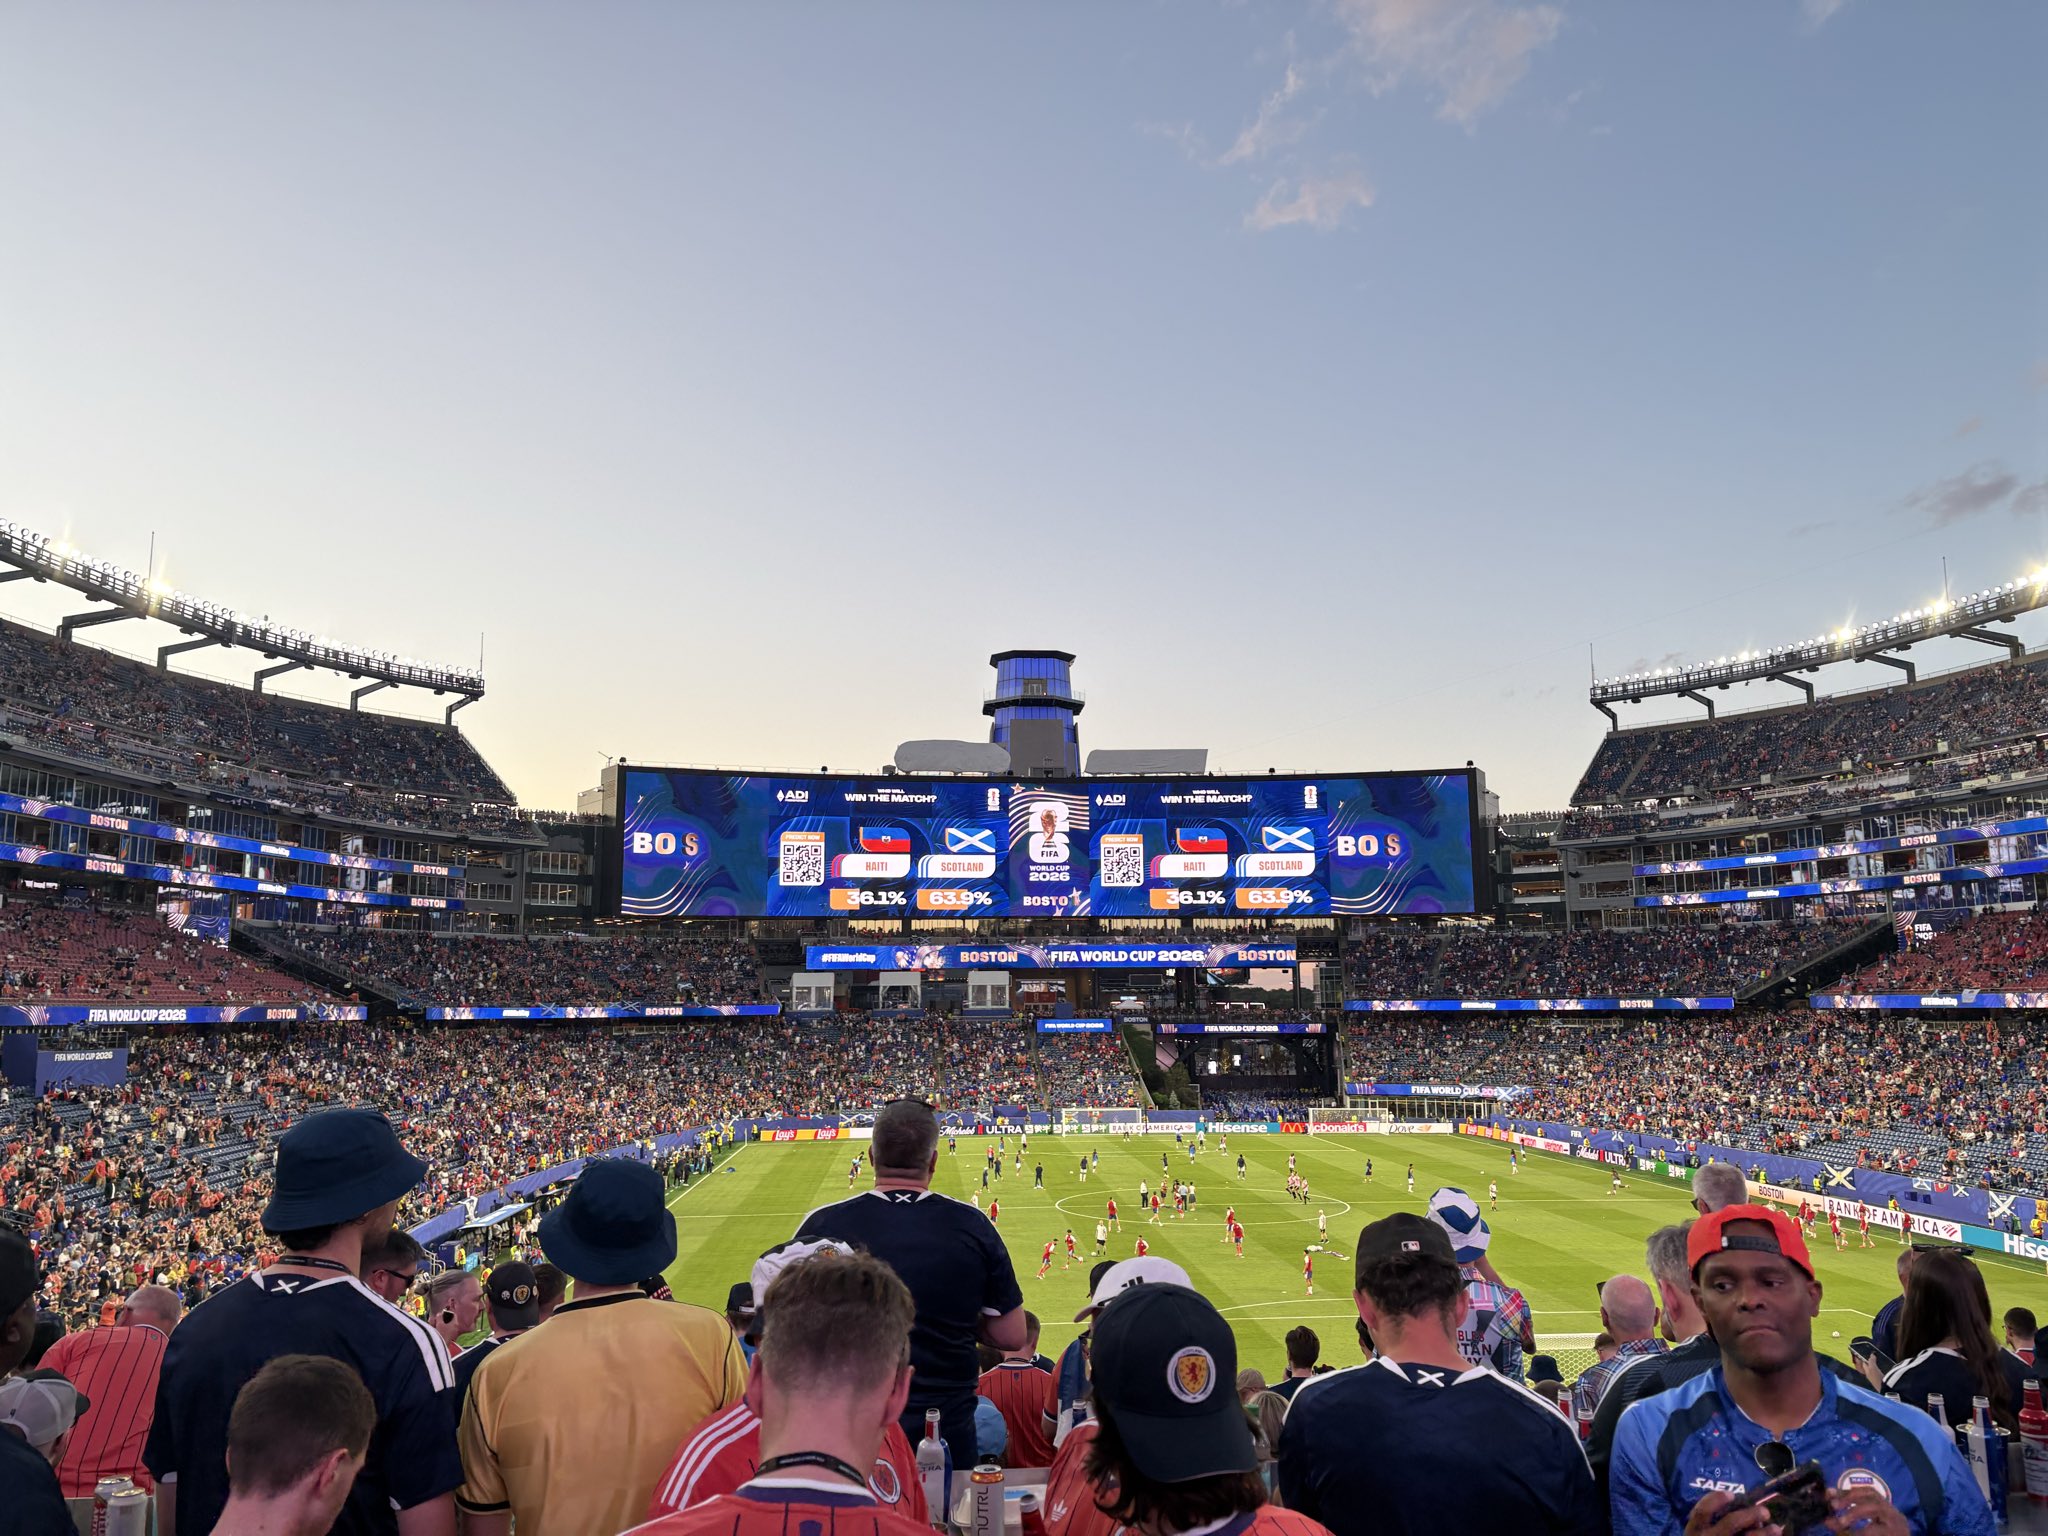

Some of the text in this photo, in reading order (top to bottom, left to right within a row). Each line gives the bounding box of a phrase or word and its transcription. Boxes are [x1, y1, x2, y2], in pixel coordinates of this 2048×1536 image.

[785, 790, 808, 799] ADI
[845, 794, 937, 803] WIN THE MATCH?
[1104, 794, 1126, 802] ADI
[1160, 794, 1252, 804] WIN THE MATCH?
[90, 814, 128, 830] BOSTON
[1900, 834, 1937, 846] BOSTON
[1040, 850, 1059, 858] FIFA
[86, 859, 124, 874] BOSTON
[413, 864, 448, 876] BOSTON
[866, 862, 888, 872] HAITI
[940, 862, 984, 872] SCOTLAND
[1183, 862, 1206, 872] HAITI
[1258, 860, 1303, 870] SCOTLAND
[1028, 872, 1070, 882] 2026
[1903, 872, 1940, 885] BOSTON
[846, 892, 906, 906] 36.1%
[930, 892, 992, 906] 63.9%
[1166, 890, 1226, 905] 36.1%
[1248, 890, 1313, 904] 63.9%
[411, 898, 446, 908] BOSTON
[1914, 924, 1932, 932] FIFA
[960, 951, 1018, 963] BOSTON
[1050, 950, 1204, 962] FIFA WORLD CUP 2026
[1238, 950, 1296, 961] BOSTON
[1620, 1000, 1654, 1008] BOSTON
[89, 1008, 187, 1022] FIFA WORLD CUP 2026
[266, 1008, 297, 1019] BOSTON
[646, 1007, 683, 1016] BOSTON
[54, 1052, 113, 1062] FIFA WORLD CUP 2026
[1411, 1086, 1431, 1094] FIFA
[1431, 1086, 1462, 1095] WORLD
[1462, 1086, 1480, 1096] CUP
[986, 1125, 1023, 1134] ULTRA
[1208, 1122, 1268, 1133] Hisense
[1389, 1124, 1414, 1134] Dove
[775, 1130, 795, 1140] Lay's
[816, 1128, 836, 1139] Lay's
[1570, 1130, 1582, 1138] FIFA
[1544, 1142, 1564, 1153] verizon
[1758, 1185, 1785, 1200] BOSTON
[1828, 1200, 1860, 1218] BANK
[1880, 1211, 1940, 1236] AMRICA
[1689, 1478, 1746, 1494] SAETA
